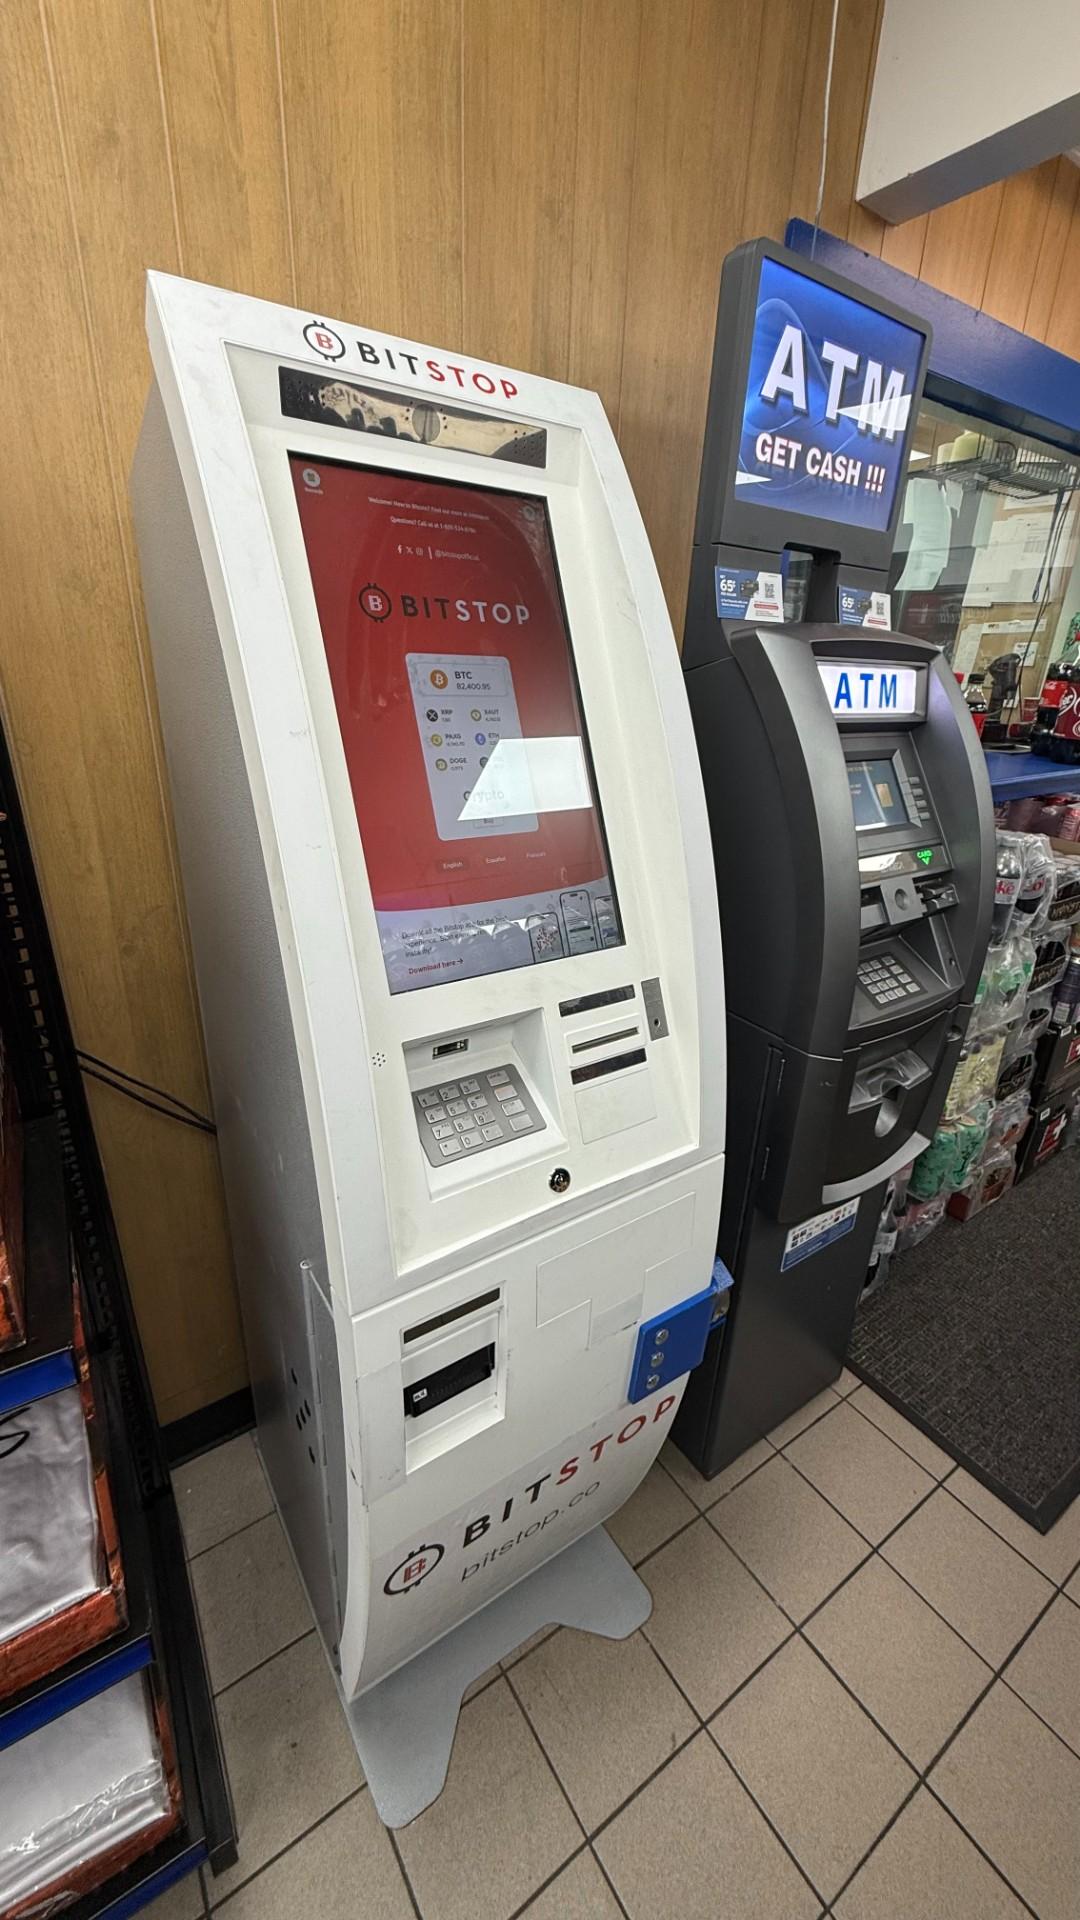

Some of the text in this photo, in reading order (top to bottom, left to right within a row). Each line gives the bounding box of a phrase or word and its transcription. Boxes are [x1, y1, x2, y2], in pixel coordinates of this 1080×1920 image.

[357, 341, 518, 399] BITSTOP
[760, 325, 905, 441] ATM
[755, 432, 886, 493] GET CASH !!!
[400, 594, 530, 625] BITSTOP
[454, 671, 473, 680] BTC
[834, 673, 897, 709] ATM
[409, 960, 456, 974] Download here
[463, 1395, 676, 1548] BITSTOP
[461, 1481, 600, 1583] bitstop.co
